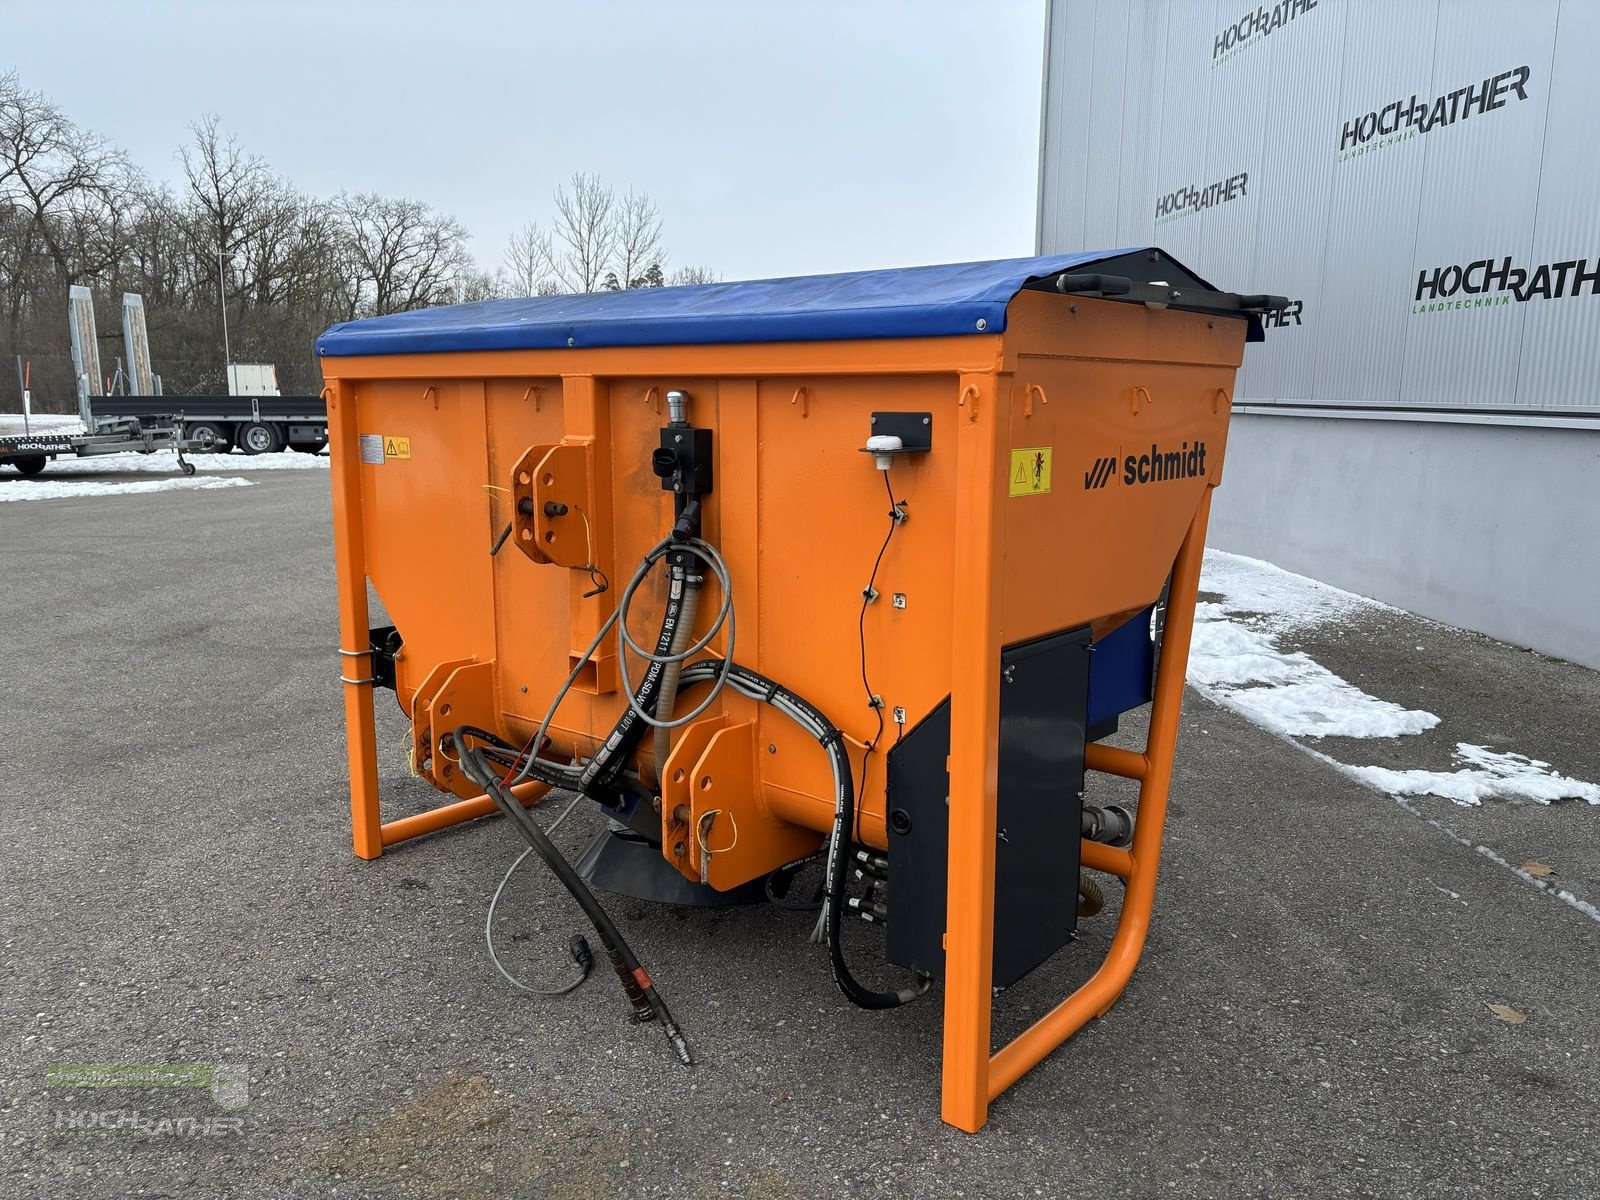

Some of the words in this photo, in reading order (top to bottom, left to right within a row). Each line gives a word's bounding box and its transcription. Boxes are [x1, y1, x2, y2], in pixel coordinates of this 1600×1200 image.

[1340, 65, 1531, 151] HOCHRATHER
[1338, 129, 1416, 163] LANDTECHNIK
[1155, 172, 1248, 219] HOCHRATHER
[1412, 295, 1510, 314] LANDTECHNIK
[1123, 441, 1206, 486] schmidt
[664, 618, 675, 630] EN
[658, 631, 671, 652] 1211
